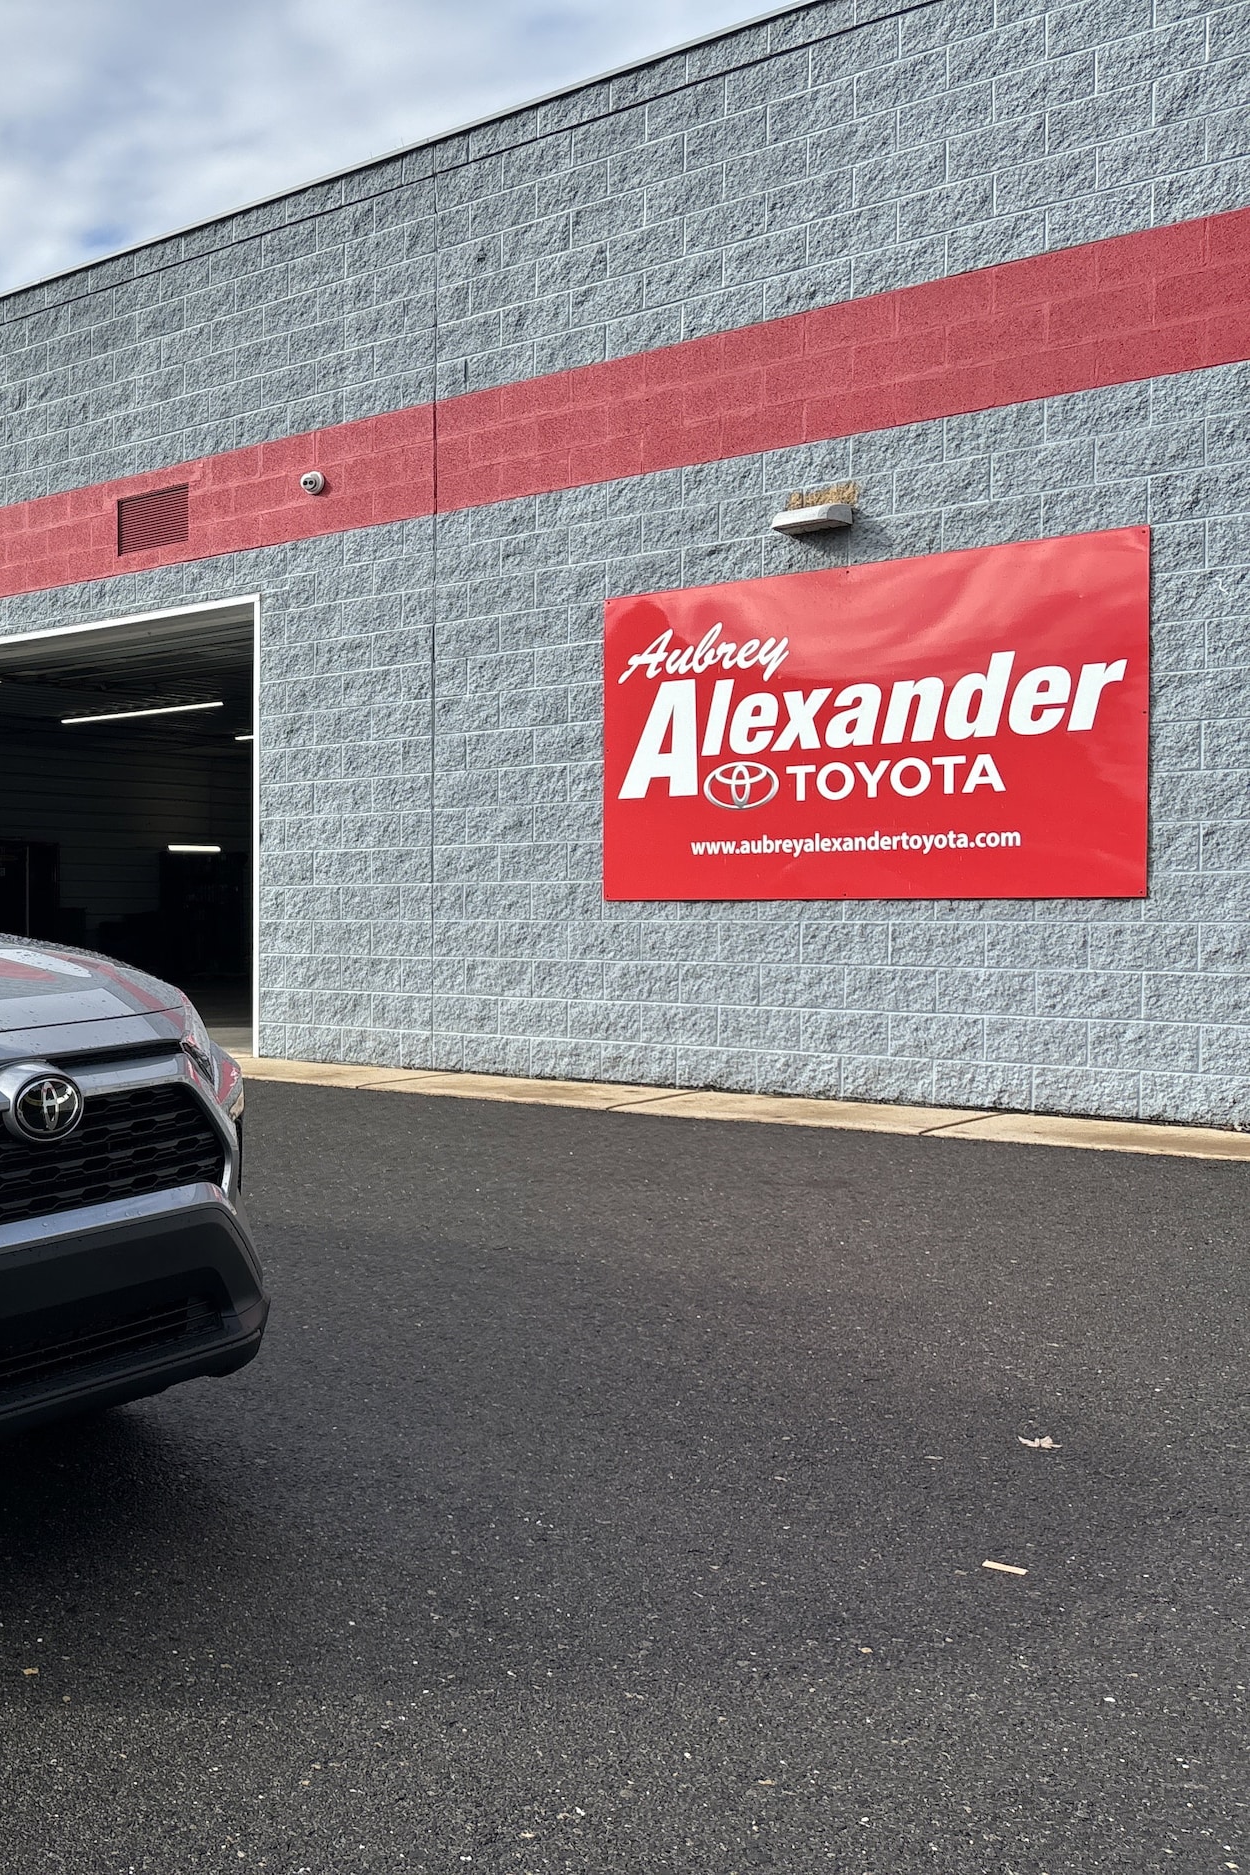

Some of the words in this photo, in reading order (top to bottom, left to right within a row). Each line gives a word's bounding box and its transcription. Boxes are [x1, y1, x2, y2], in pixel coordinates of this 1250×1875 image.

[618, 622, 790, 682] Aubrey
[618, 650, 1128, 800] Alexander
[786, 753, 1007, 801] TOYOTA
[691, 828, 1022, 859] www.aubreyalexandertoyota.com
